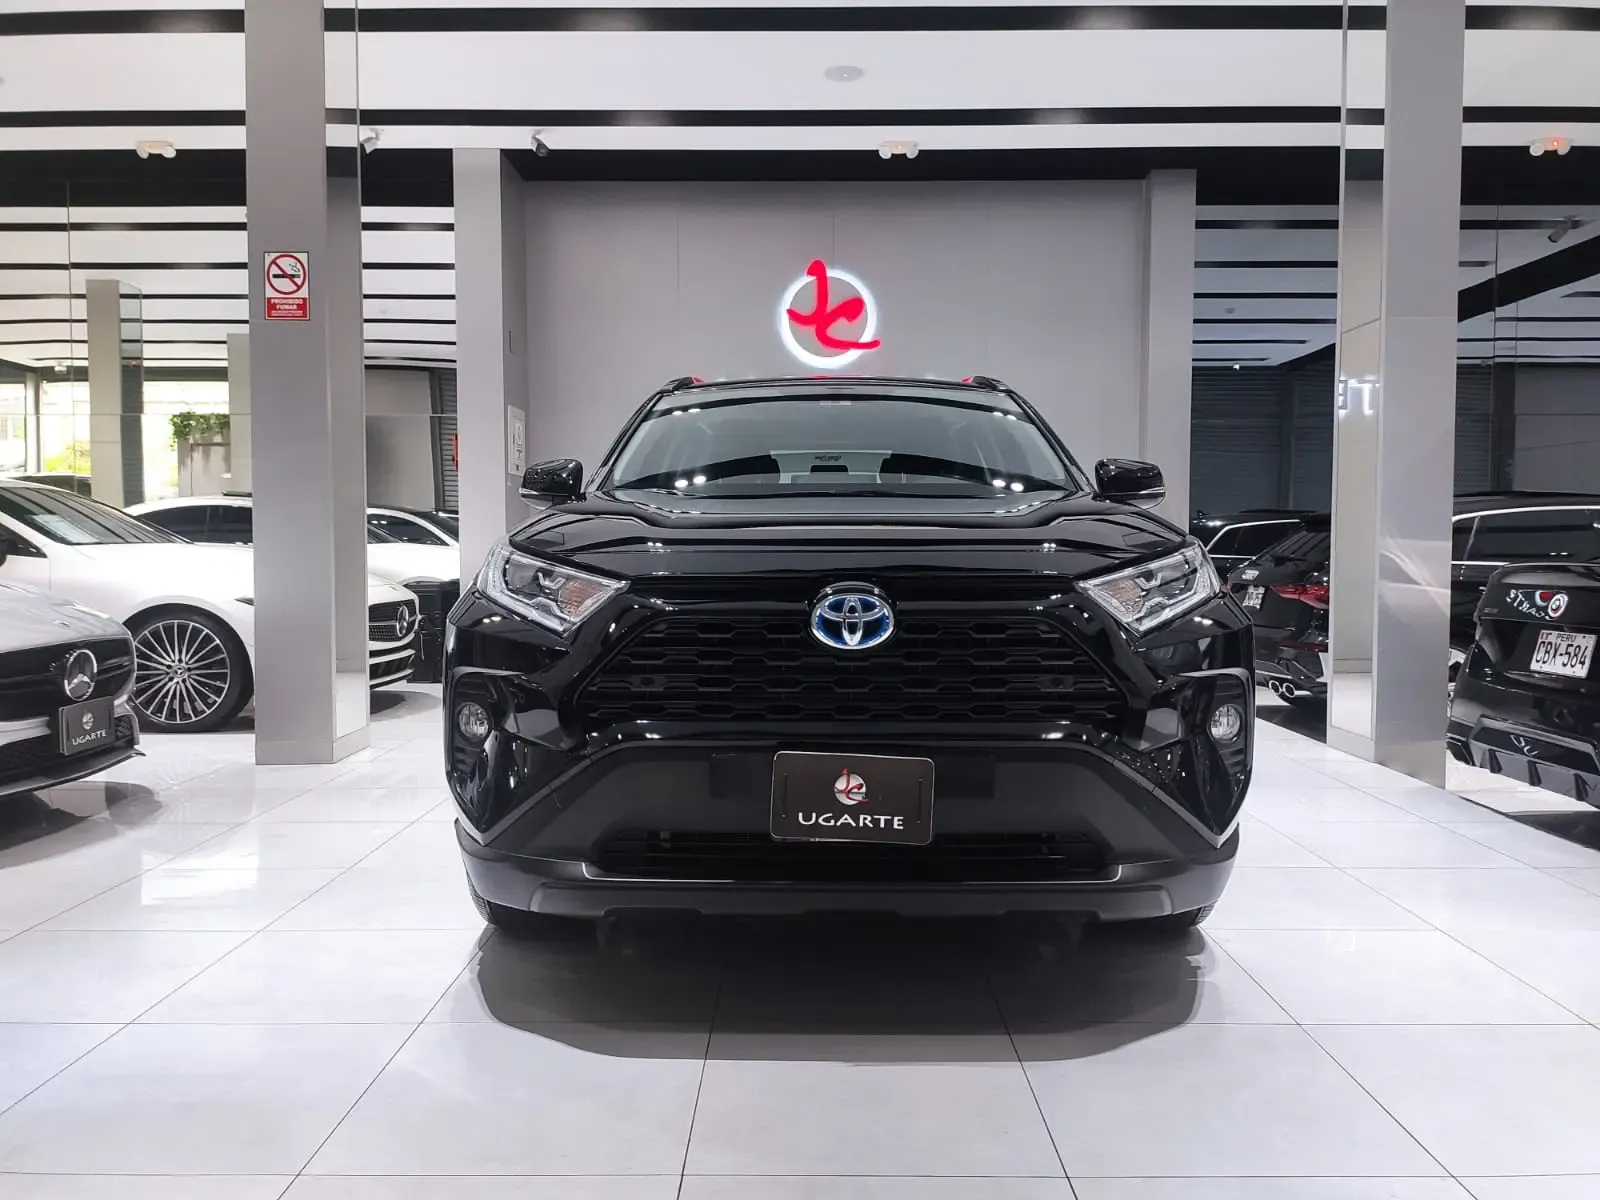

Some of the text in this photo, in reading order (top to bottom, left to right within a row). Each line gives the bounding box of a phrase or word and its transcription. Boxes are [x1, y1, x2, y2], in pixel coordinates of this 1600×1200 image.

[1556, 632, 1577, 642] PERU
[1535, 641, 1588, 670] CBX-584
[72, 729, 107, 746] UGARTE
[798, 812, 904, 830] UGARTE
